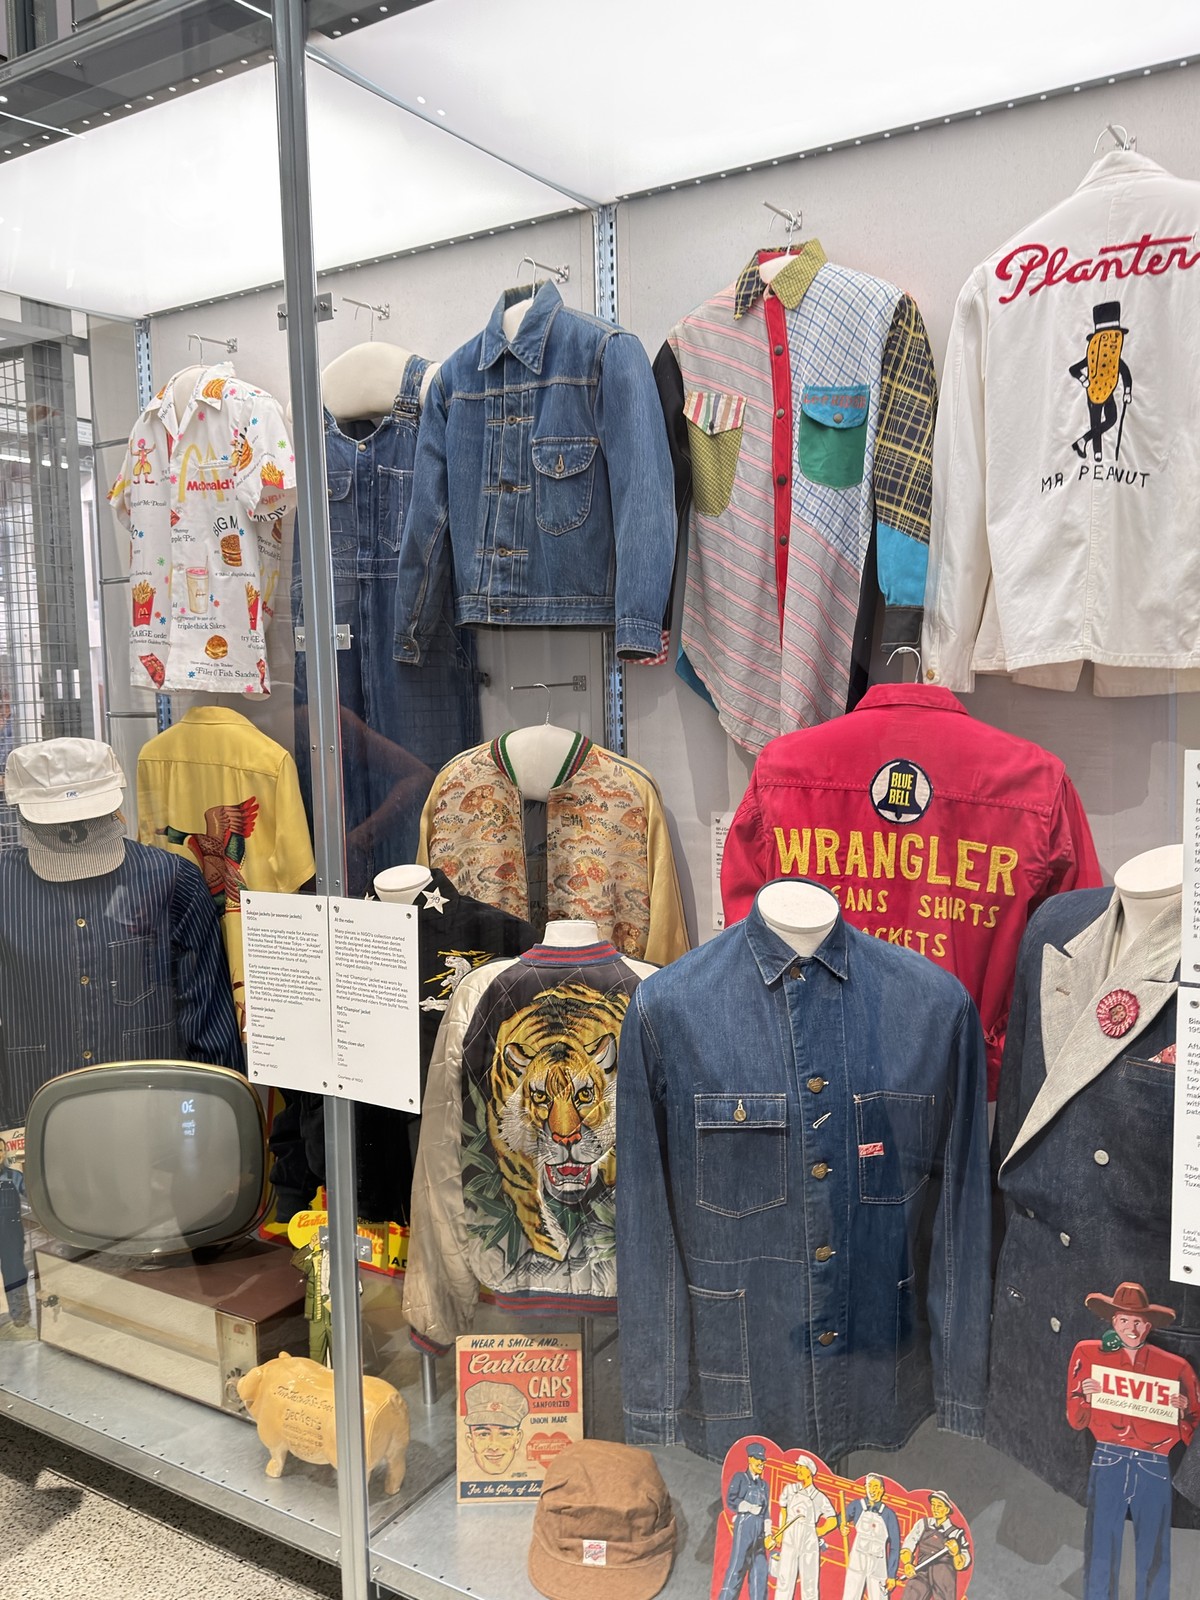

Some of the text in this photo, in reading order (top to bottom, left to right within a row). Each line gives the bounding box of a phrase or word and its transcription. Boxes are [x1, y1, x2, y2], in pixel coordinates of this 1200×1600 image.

[1041, 464, 1150, 493] MR PEANUT
[891, 772, 913, 791] BLUE
[888, 788, 911, 807] BELL
[774, 827, 1019, 896] WRANGLER
[831, 885, 1000, 929] EANS SHIRTS
[471, 1339, 496, 1348] WEAR
[508, 1339, 534, 1347] SMILE
[468, 1352, 570, 1375] Carhartt
[528, 1376, 572, 1399] CAPS
[1102, 1373, 1170, 1406] LEVI'S
[1097, 1397, 1174, 1418] AMERICA'S FINEST OVERALL
[467, 1482, 541, 1495] For the Glory of Un
